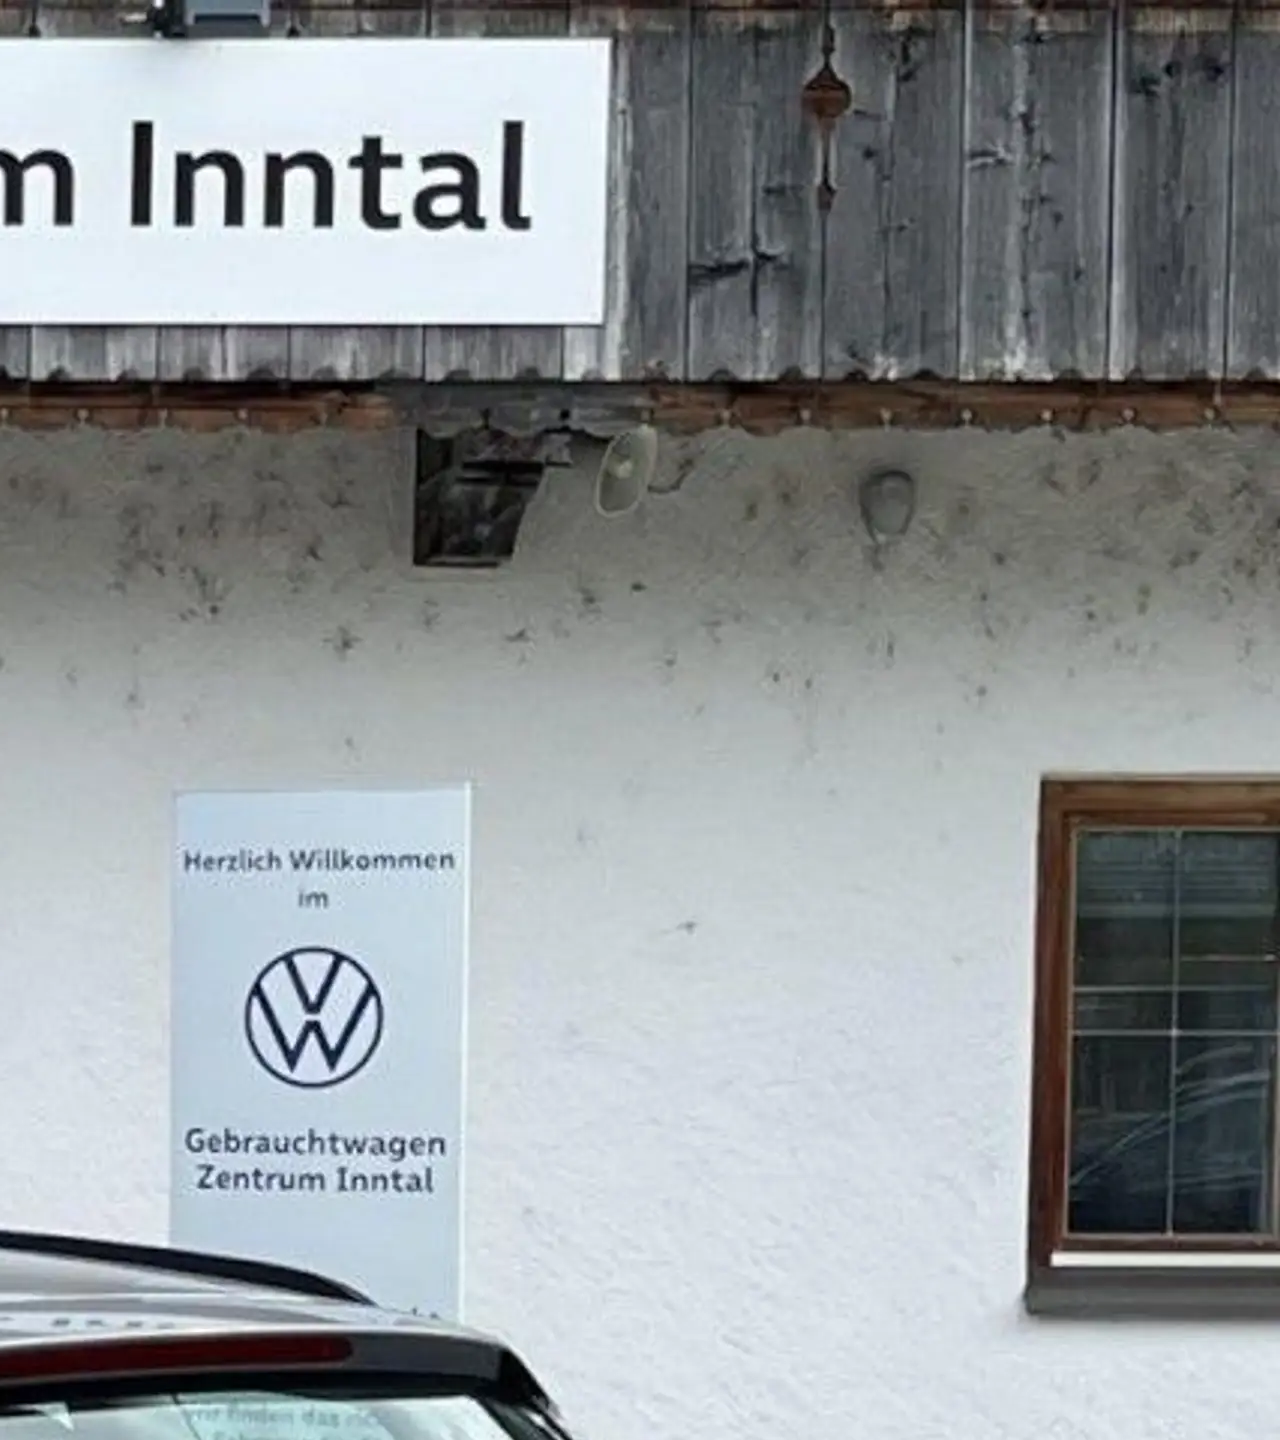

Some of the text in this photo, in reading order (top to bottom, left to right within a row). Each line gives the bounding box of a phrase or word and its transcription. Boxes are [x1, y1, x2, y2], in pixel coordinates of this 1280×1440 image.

[130, 120, 532, 231] Inntal
[183, 848, 455, 872] Herzlich Willkommen
[298, 890, 329, 909] im
[245, 947, 383, 1089] VW
[184, 1127, 446, 1163] Gebrauchtwagen
[196, 1163, 434, 1194] Zentrum Inntal
